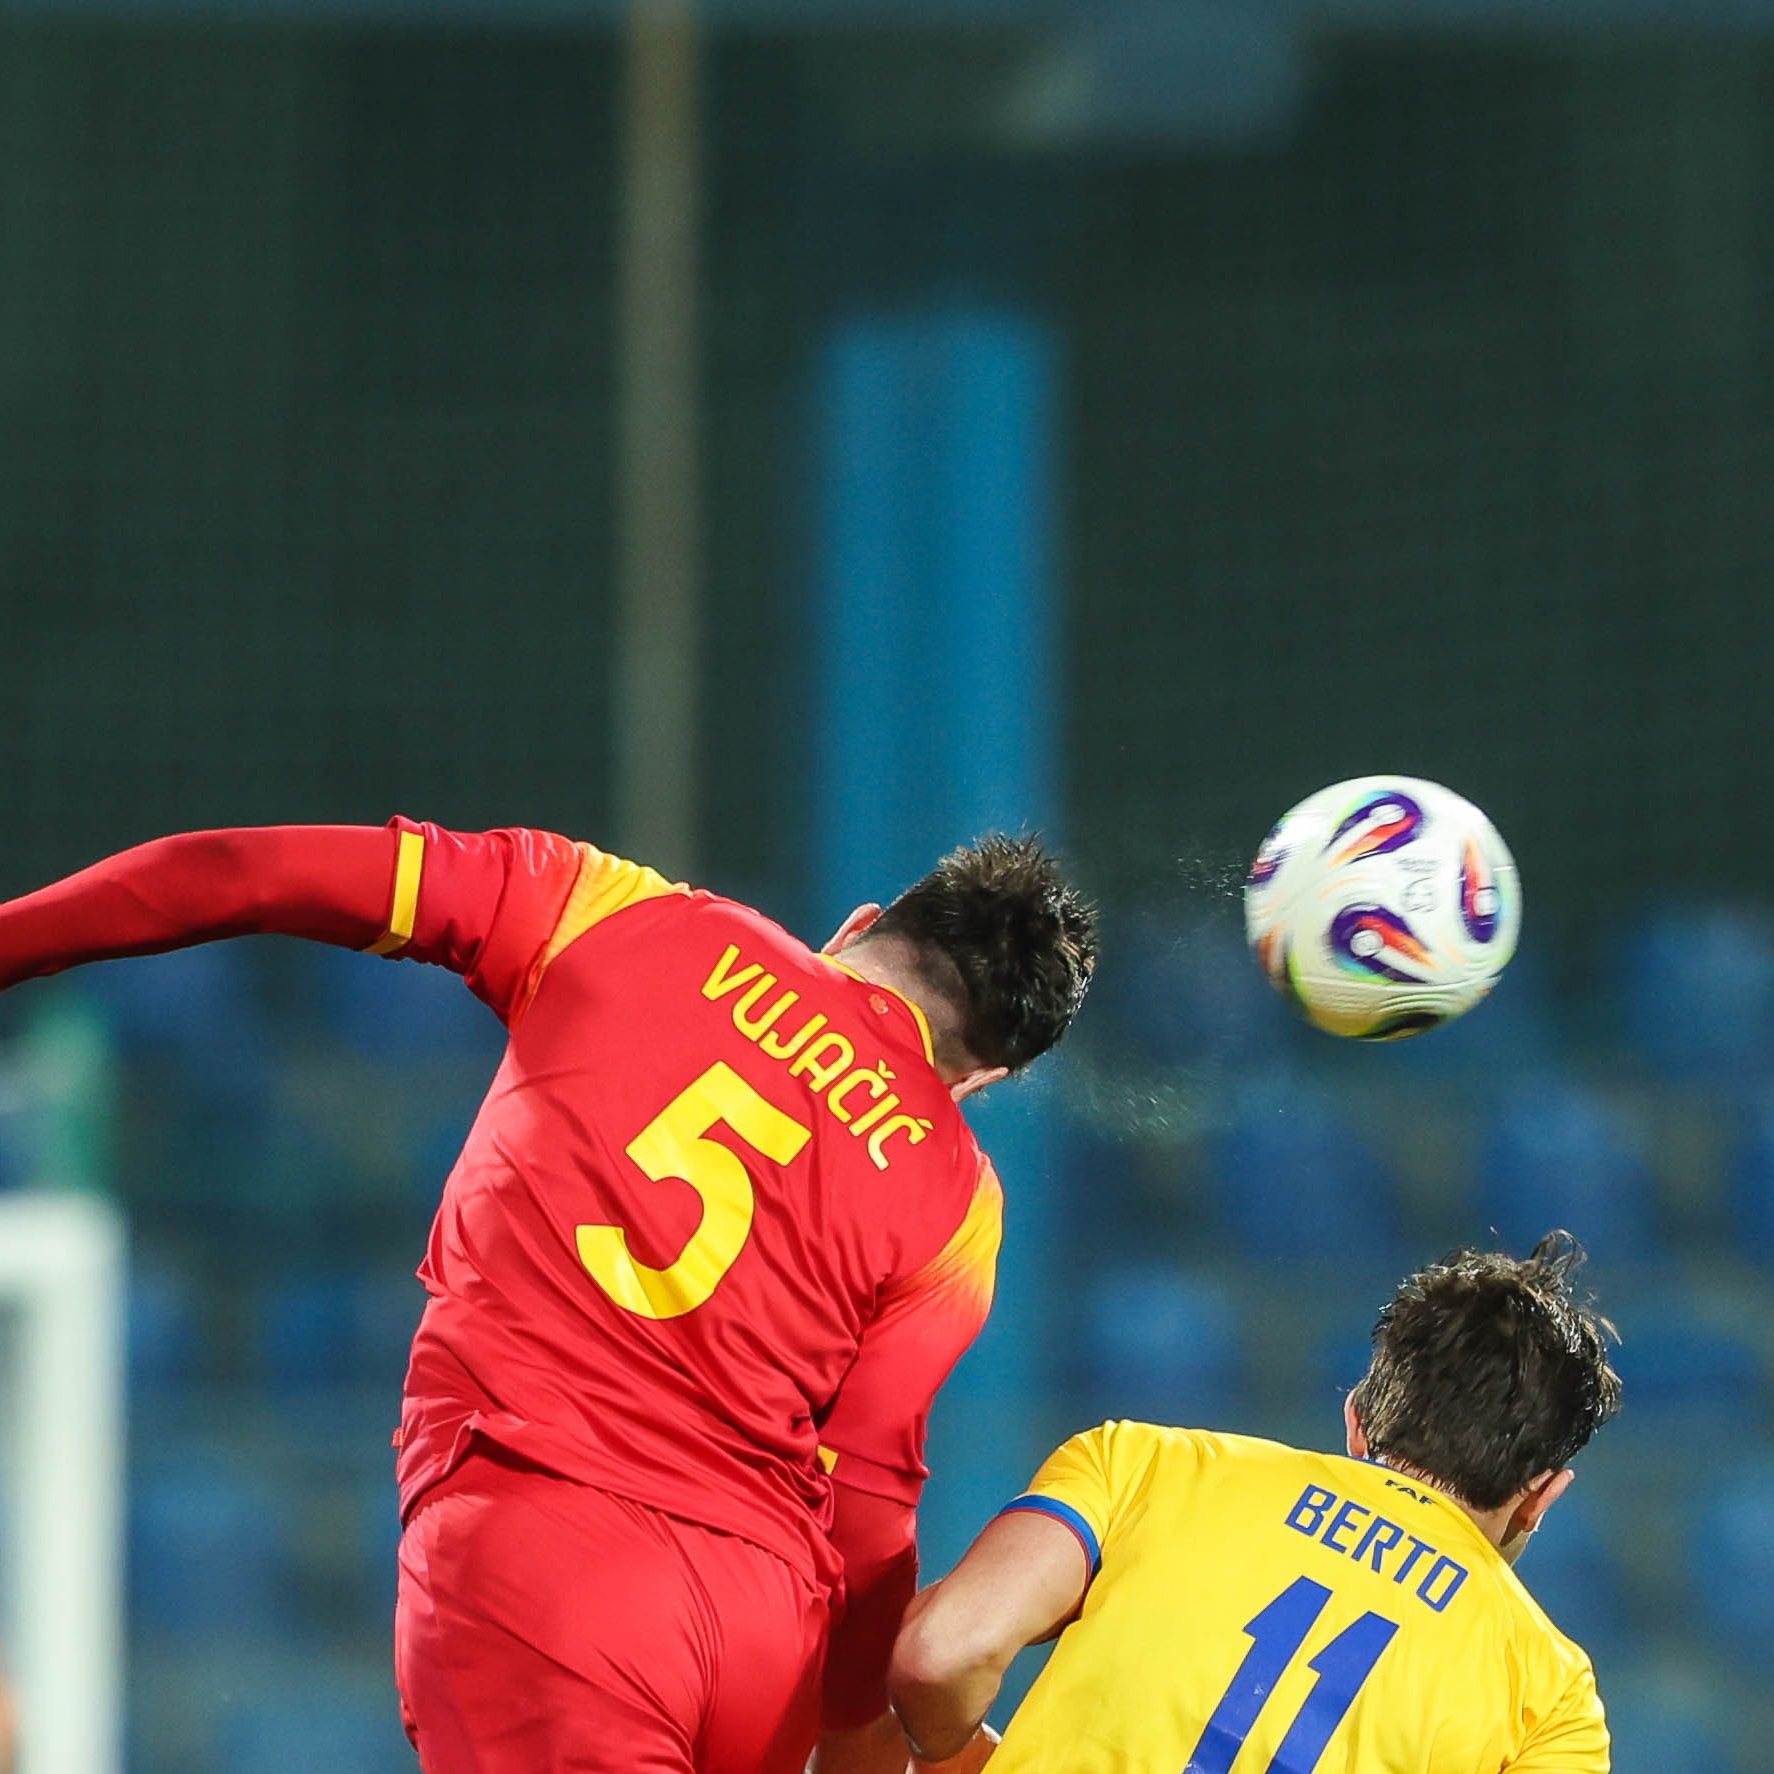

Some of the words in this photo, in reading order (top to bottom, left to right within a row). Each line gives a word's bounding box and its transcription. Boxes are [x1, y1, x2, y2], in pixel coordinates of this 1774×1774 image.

[701, 944, 933, 1171] VUJAČIĆ
[575, 1060, 813, 1319] 5
[1285, 1483, 1469, 1613] BERTO
